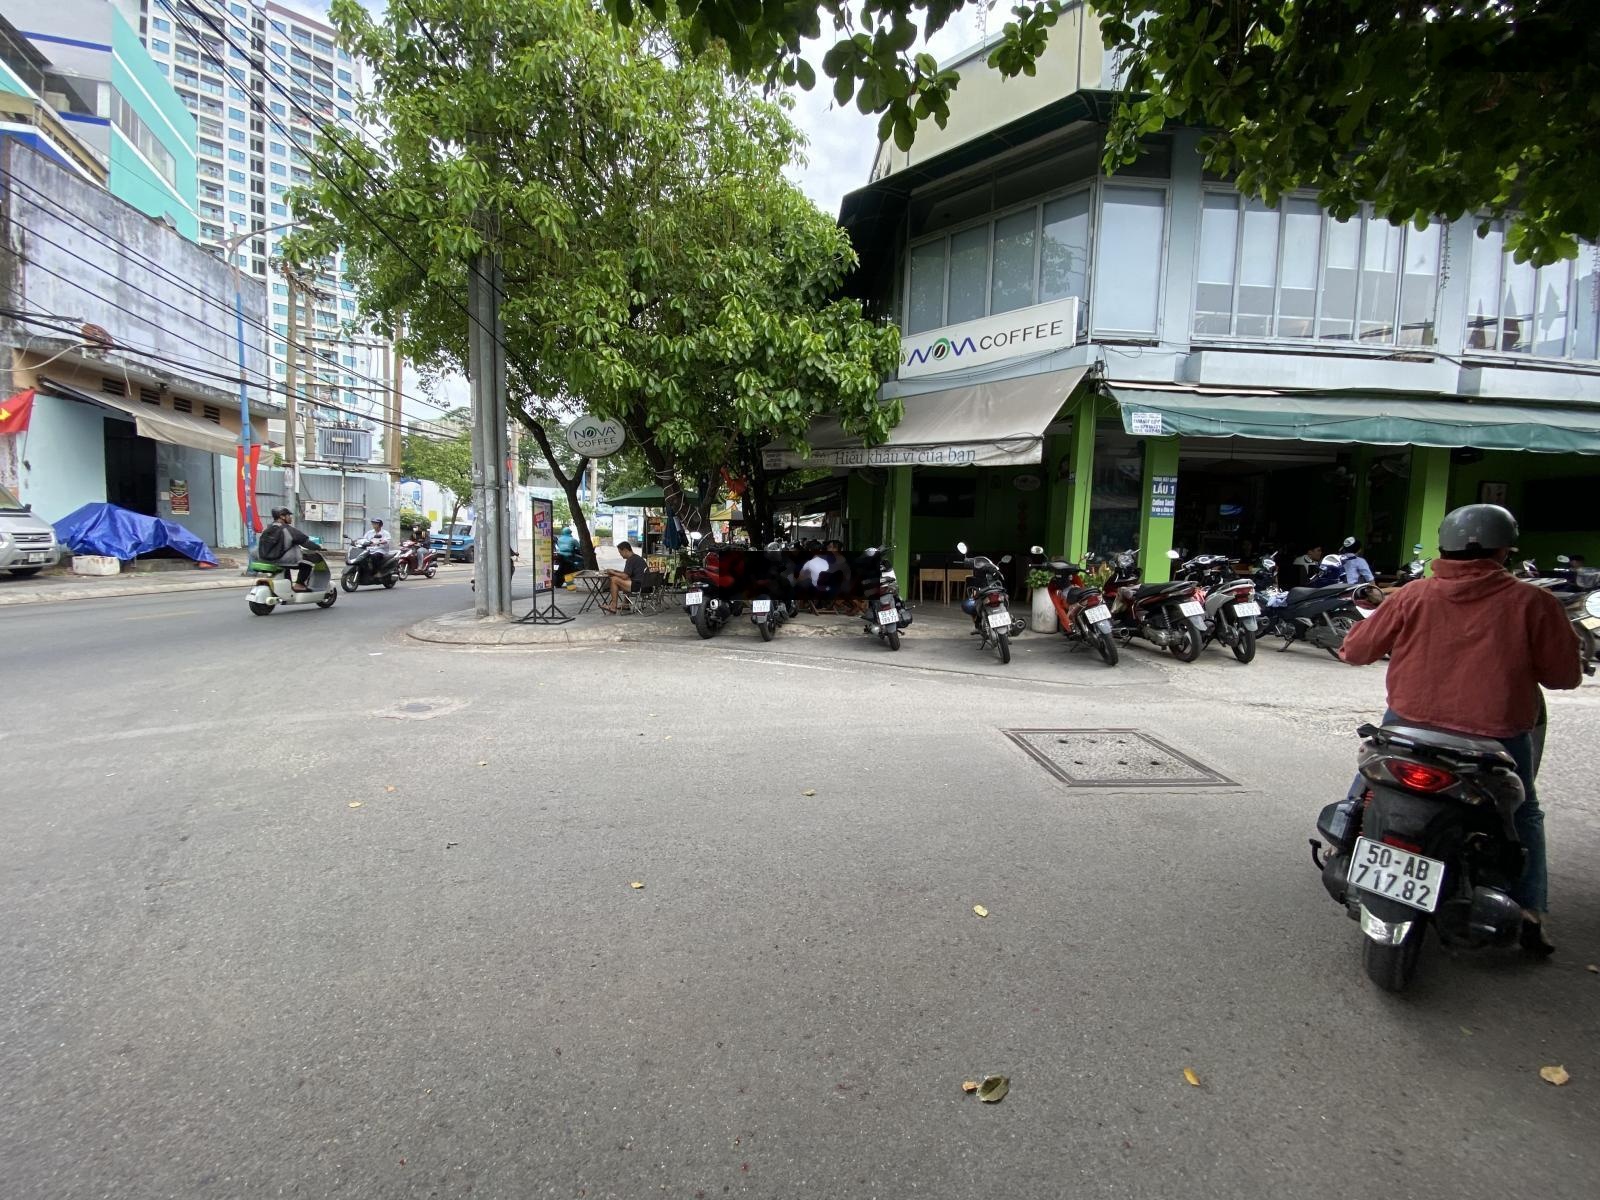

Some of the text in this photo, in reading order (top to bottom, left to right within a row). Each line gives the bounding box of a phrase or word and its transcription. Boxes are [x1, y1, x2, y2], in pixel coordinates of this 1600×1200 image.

[907, 320, 1063, 366] NOVA COFFEE
[574, 426, 616, 439] NOVA
[578, 437, 617, 448] COFFEE
[1367, 844, 1430, 881] 50-AB
[1355, 863, 1431, 907] 717.82
